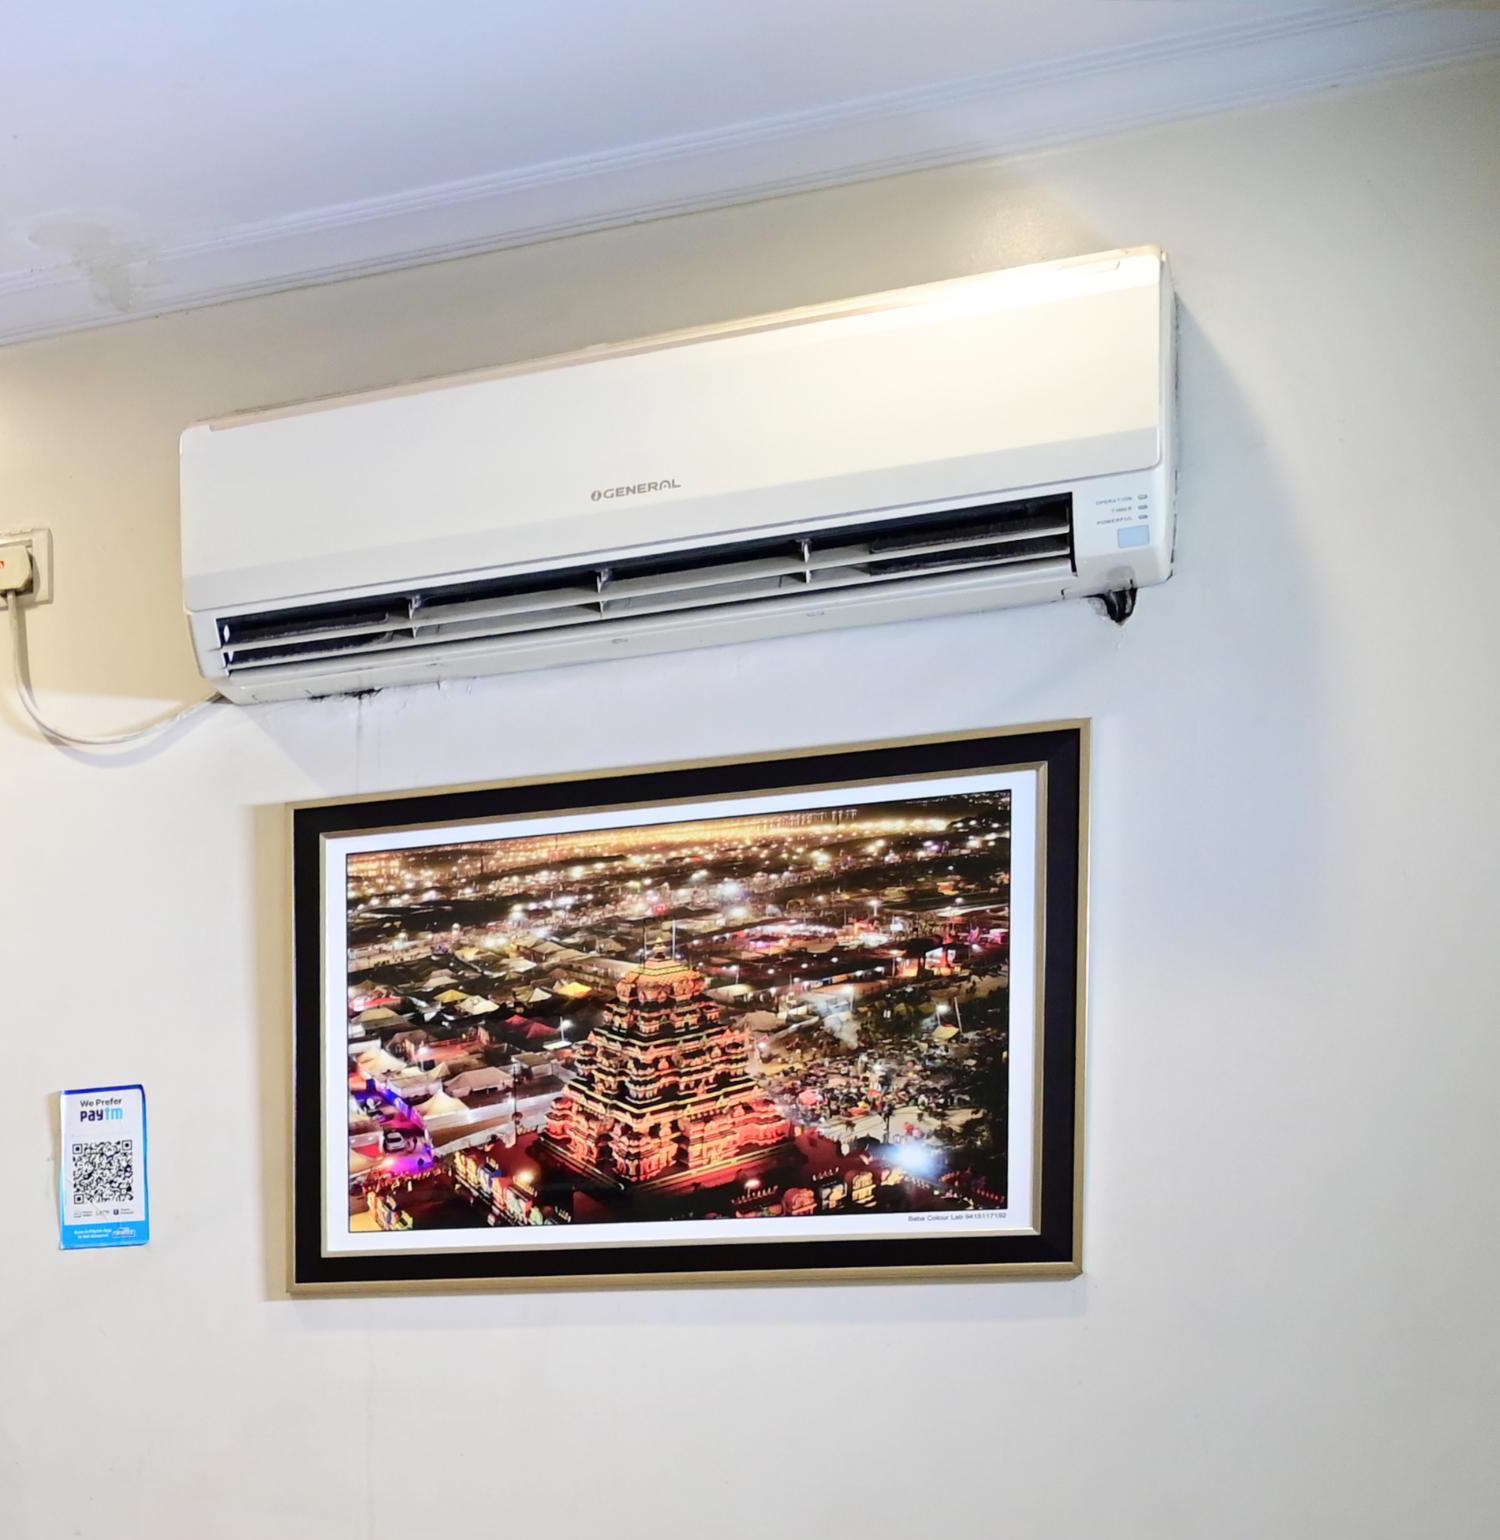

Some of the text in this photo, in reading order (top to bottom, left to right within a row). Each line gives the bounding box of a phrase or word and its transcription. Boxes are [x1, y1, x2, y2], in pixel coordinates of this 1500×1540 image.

[80, 1097, 122, 1107] We Prefer
[80, 1107, 124, 1122] paytm
